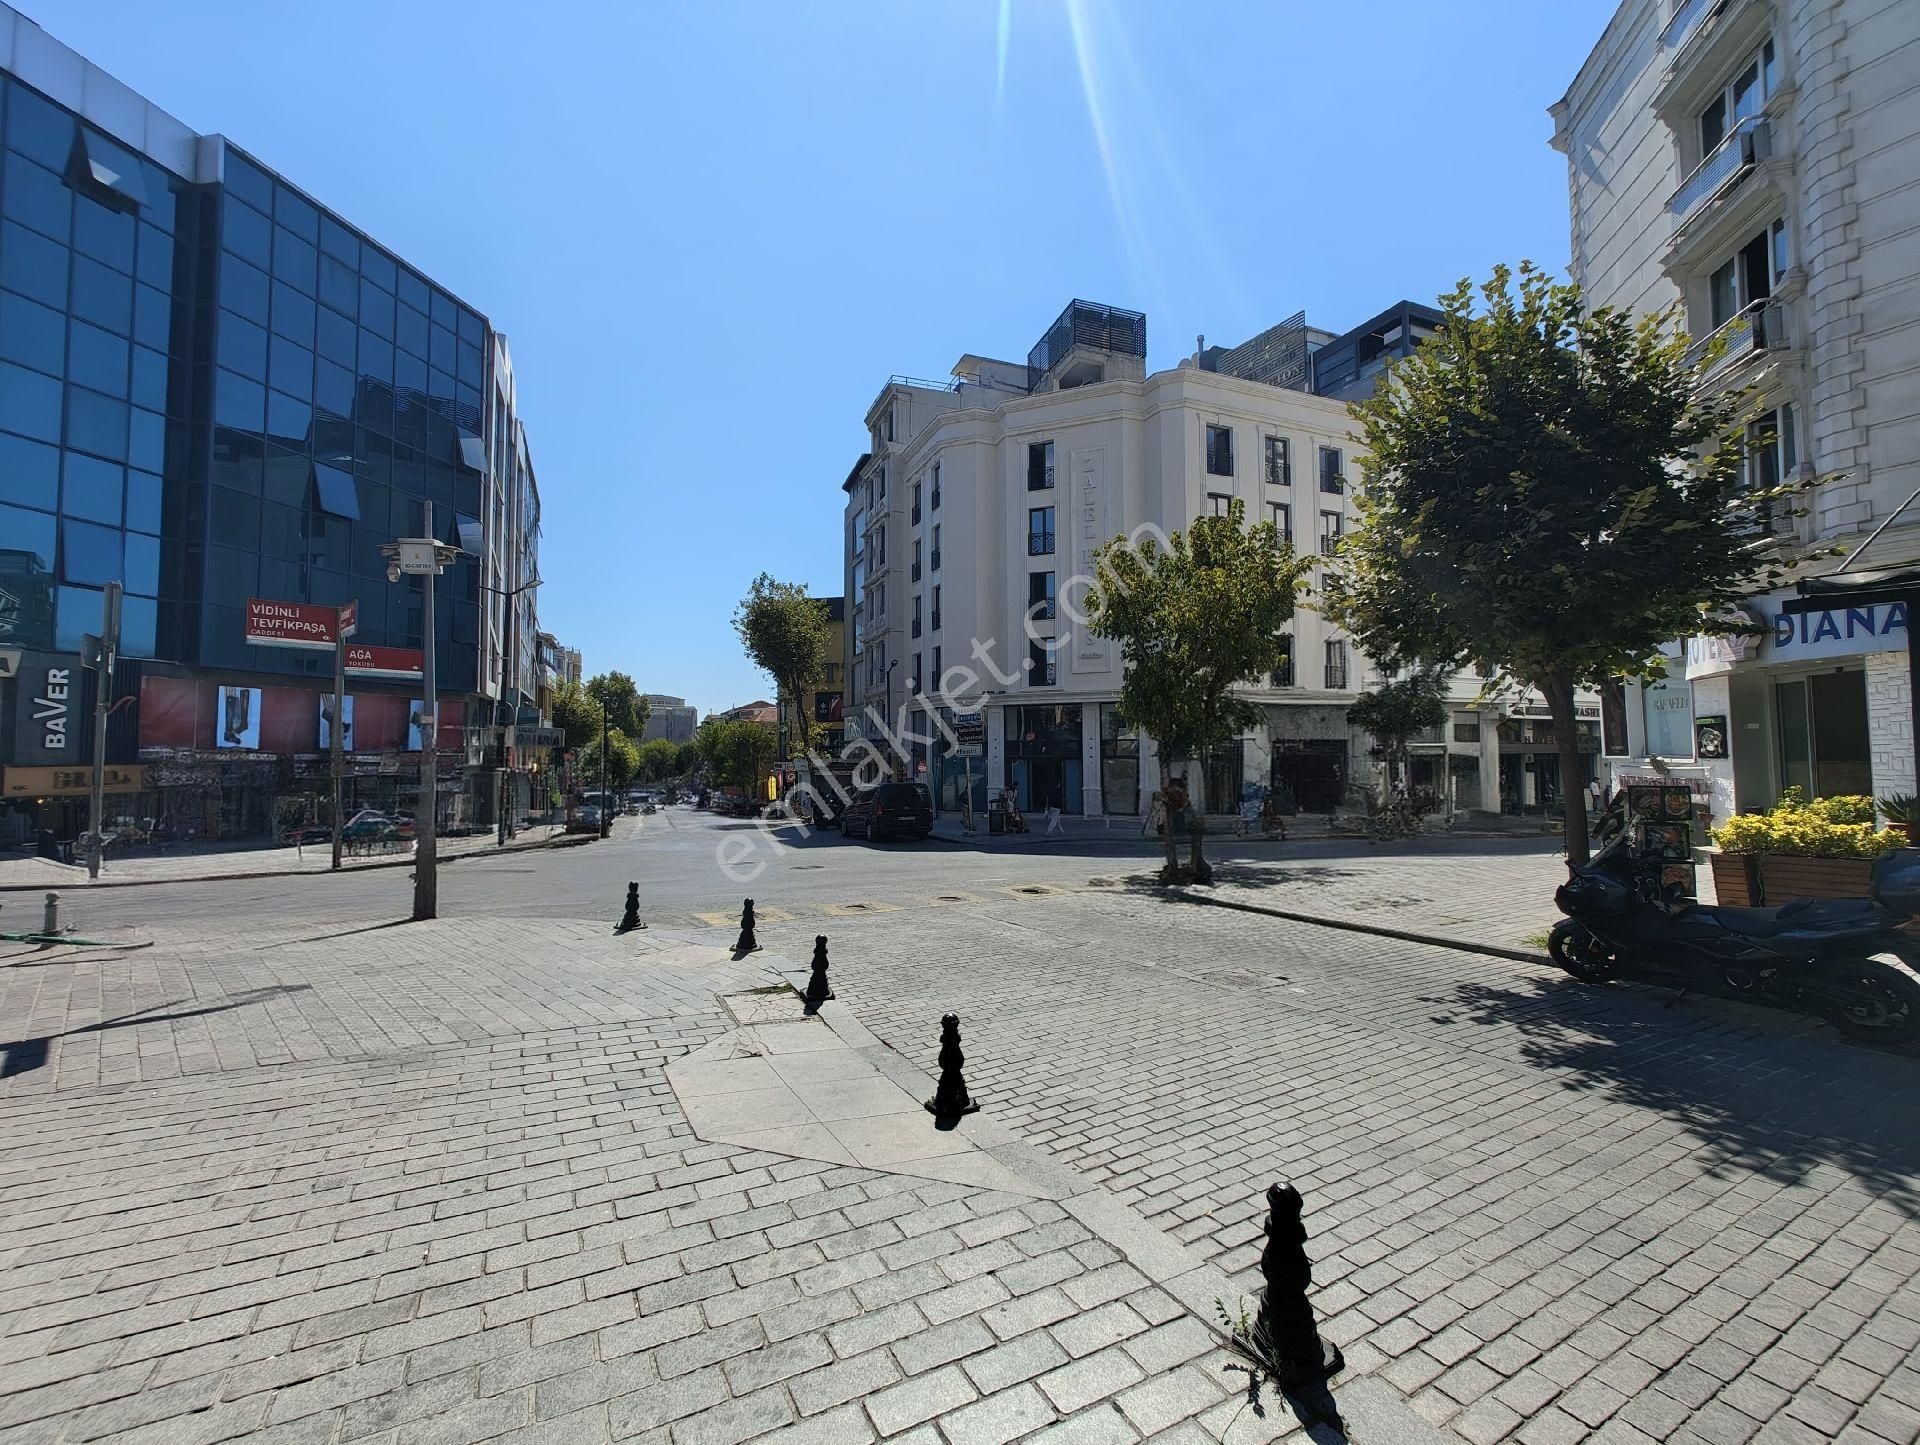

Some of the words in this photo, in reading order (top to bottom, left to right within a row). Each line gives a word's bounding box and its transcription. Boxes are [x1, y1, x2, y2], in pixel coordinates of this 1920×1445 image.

[251, 617, 327, 634] TEVFİKPAŞA
[1774, 603, 1907, 648] DIANA
[349, 649, 372, 660] AĞA
[32, 668, 70, 748] BAVER
